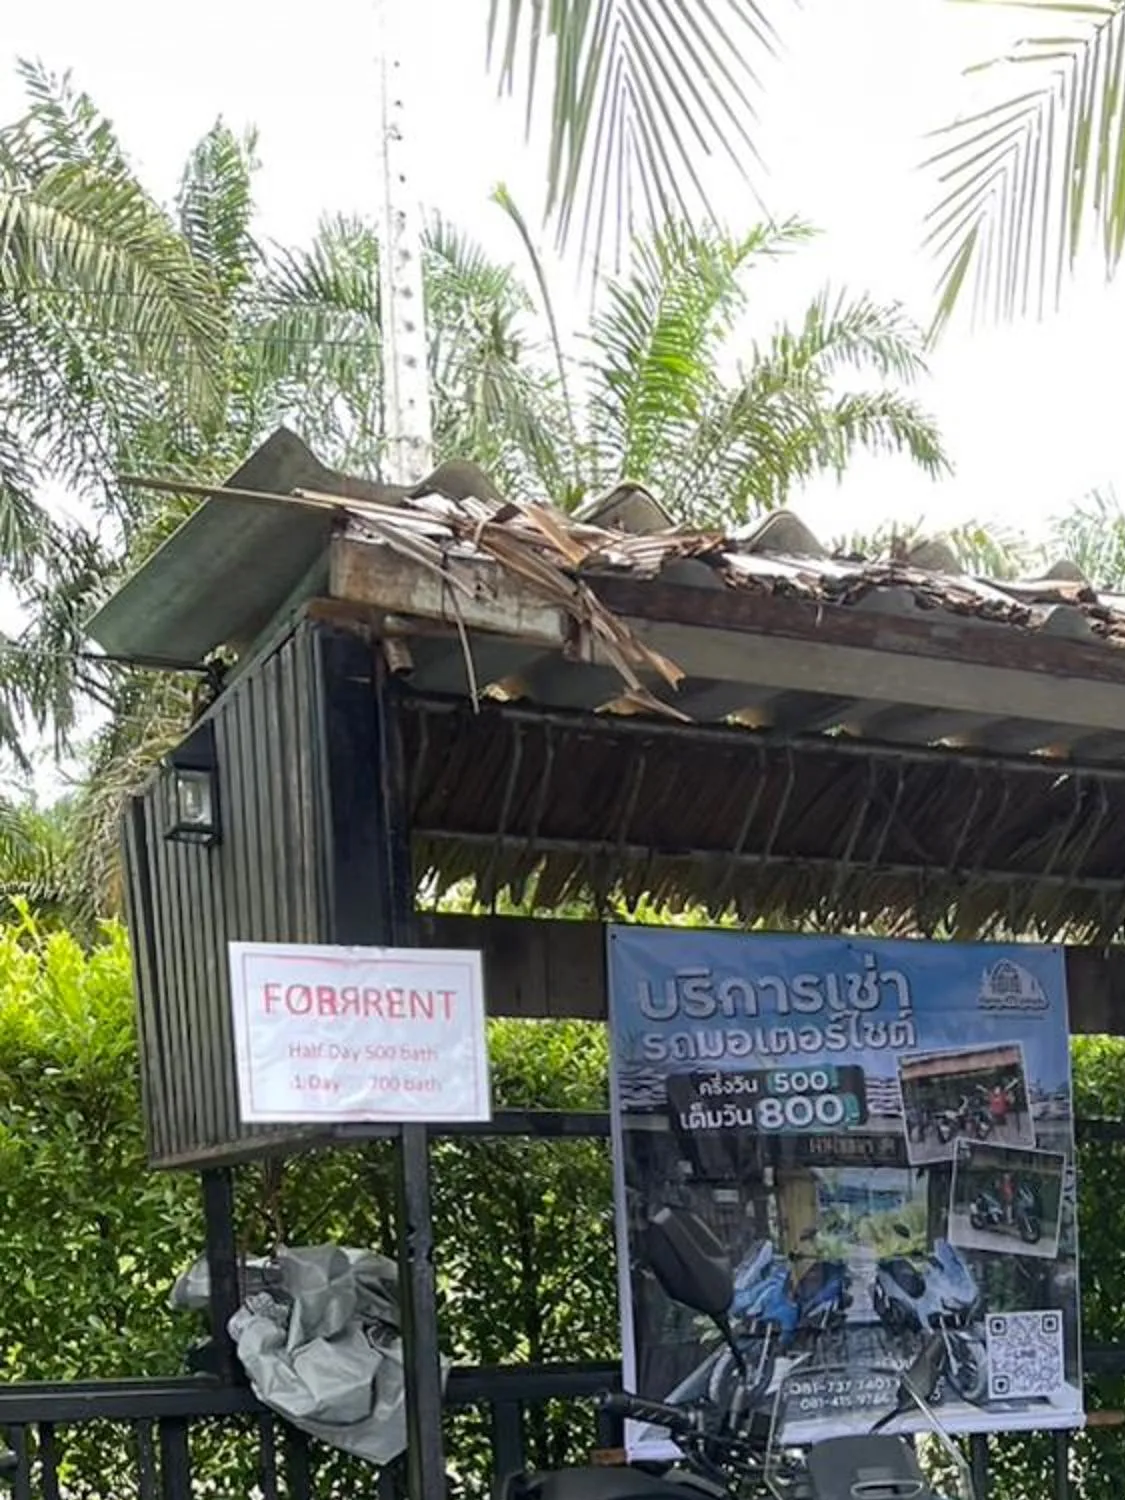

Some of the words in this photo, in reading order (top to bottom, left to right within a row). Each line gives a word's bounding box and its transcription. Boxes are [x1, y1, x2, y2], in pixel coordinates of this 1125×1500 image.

[638, 953, 912, 1020] บริการเช่า
[288, 1042, 322, 1059] Half
[328, 1043, 361, 1063] Day
[365, 1044, 396, 1060] 500
[308, 1074, 341, 1093] Day
[369, 1075, 400, 1092] 700
[680, 1101, 754, 1130] เต็มวัน
